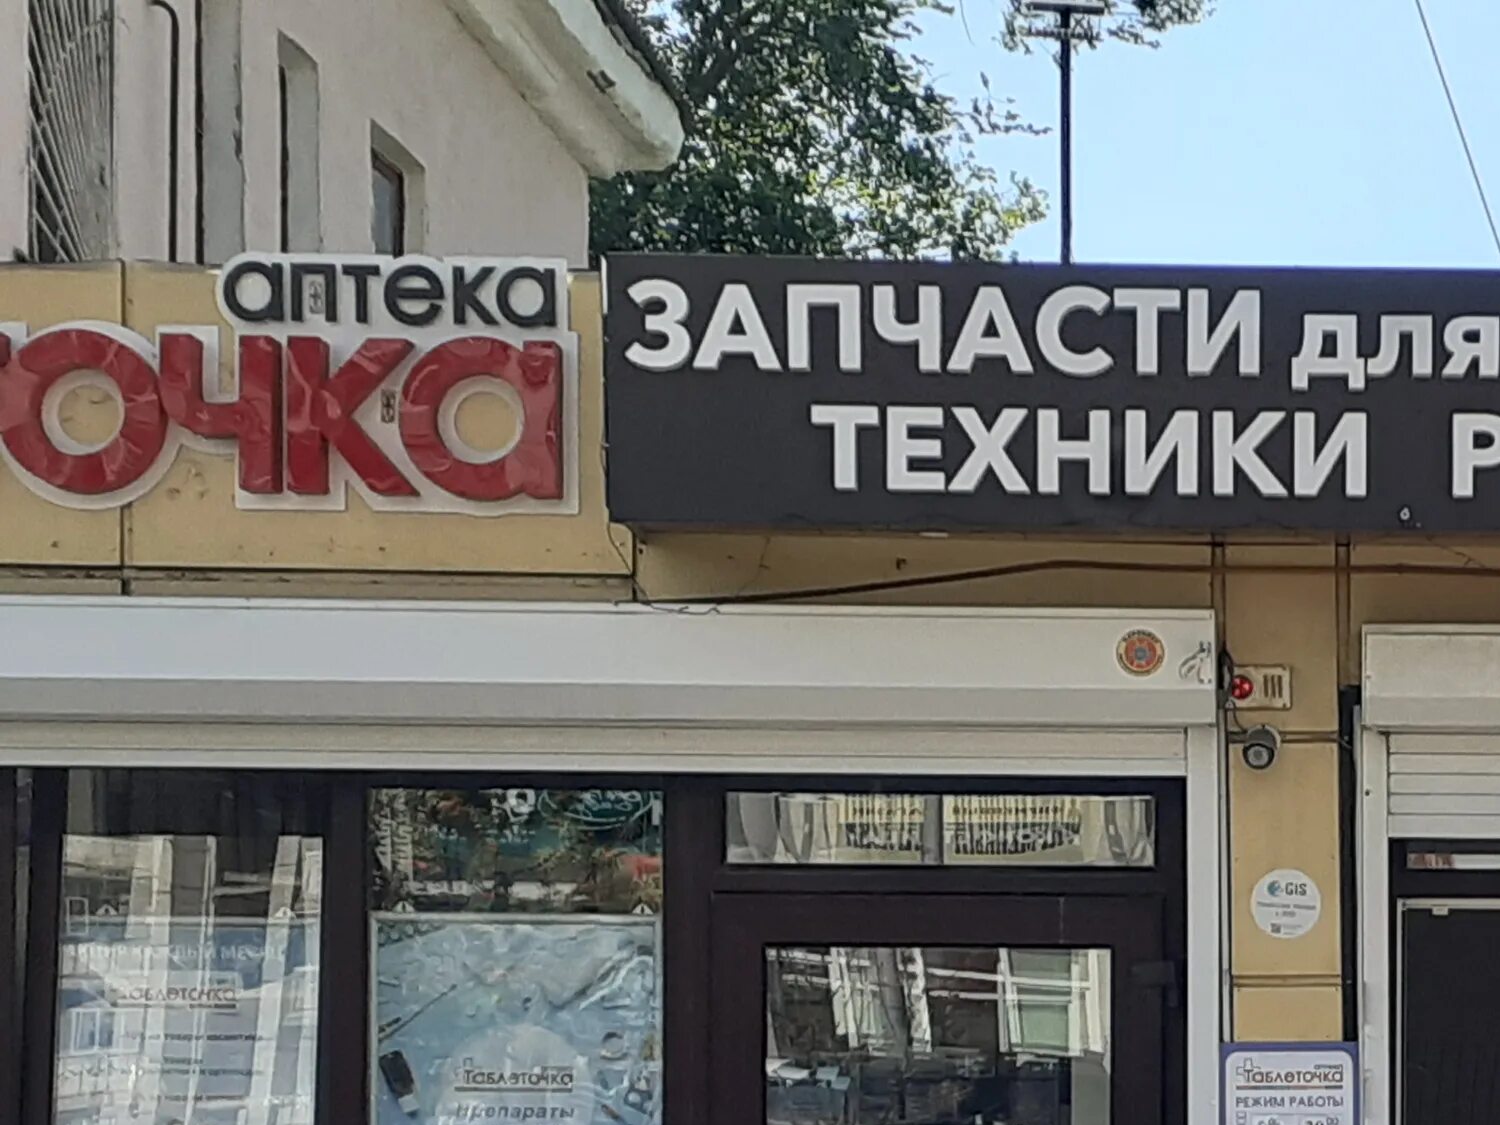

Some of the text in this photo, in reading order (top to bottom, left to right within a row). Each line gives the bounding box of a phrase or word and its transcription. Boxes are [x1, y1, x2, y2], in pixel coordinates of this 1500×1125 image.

[223, 260, 557, 327] аптека
[625, 278, 1262, 377] ЗАПЧАСТИ
[1290, 314, 1500, 391] для
[0, 326, 564, 502] очка
[810, 405, 1368, 498] ТЕХНИКИ
[1235, 1095, 1344, 1108] РЕЖИМ РАБОТЫ
